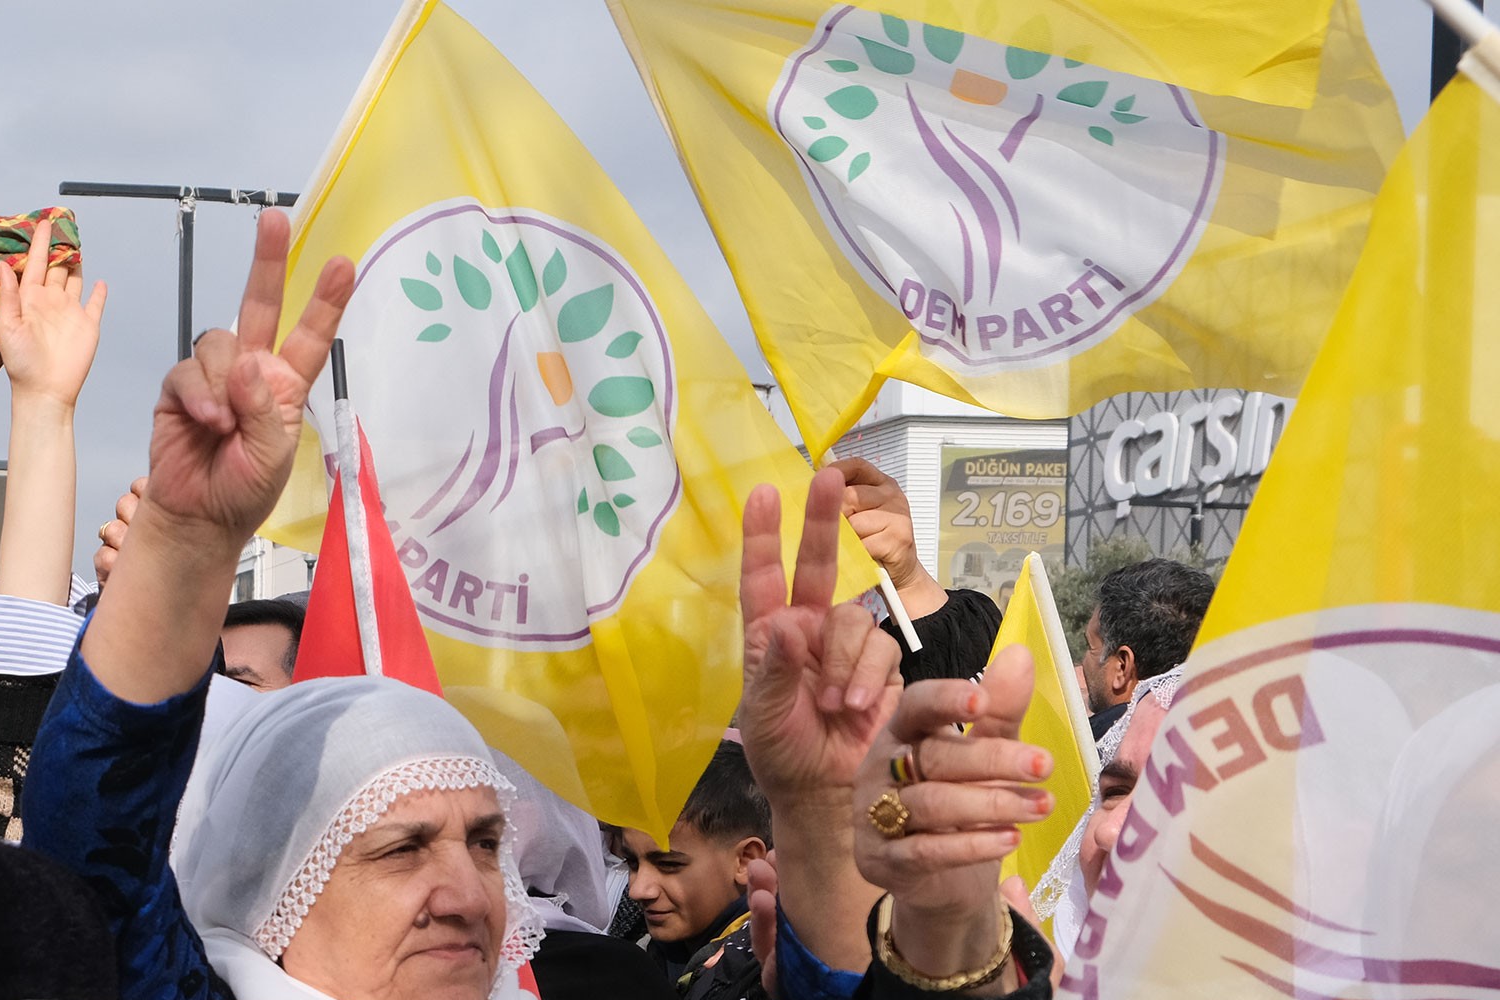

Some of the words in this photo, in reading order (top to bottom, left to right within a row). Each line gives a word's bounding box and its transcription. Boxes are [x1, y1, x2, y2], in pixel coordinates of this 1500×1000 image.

[899, 278, 967, 349] DEM
[976, 258, 1126, 351] PARTİ
[965, 459, 1020, 475] DÜĞÜN
[986, 529, 1048, 545] TAKSİTLE
[396, 537, 530, 624] PARTİ
